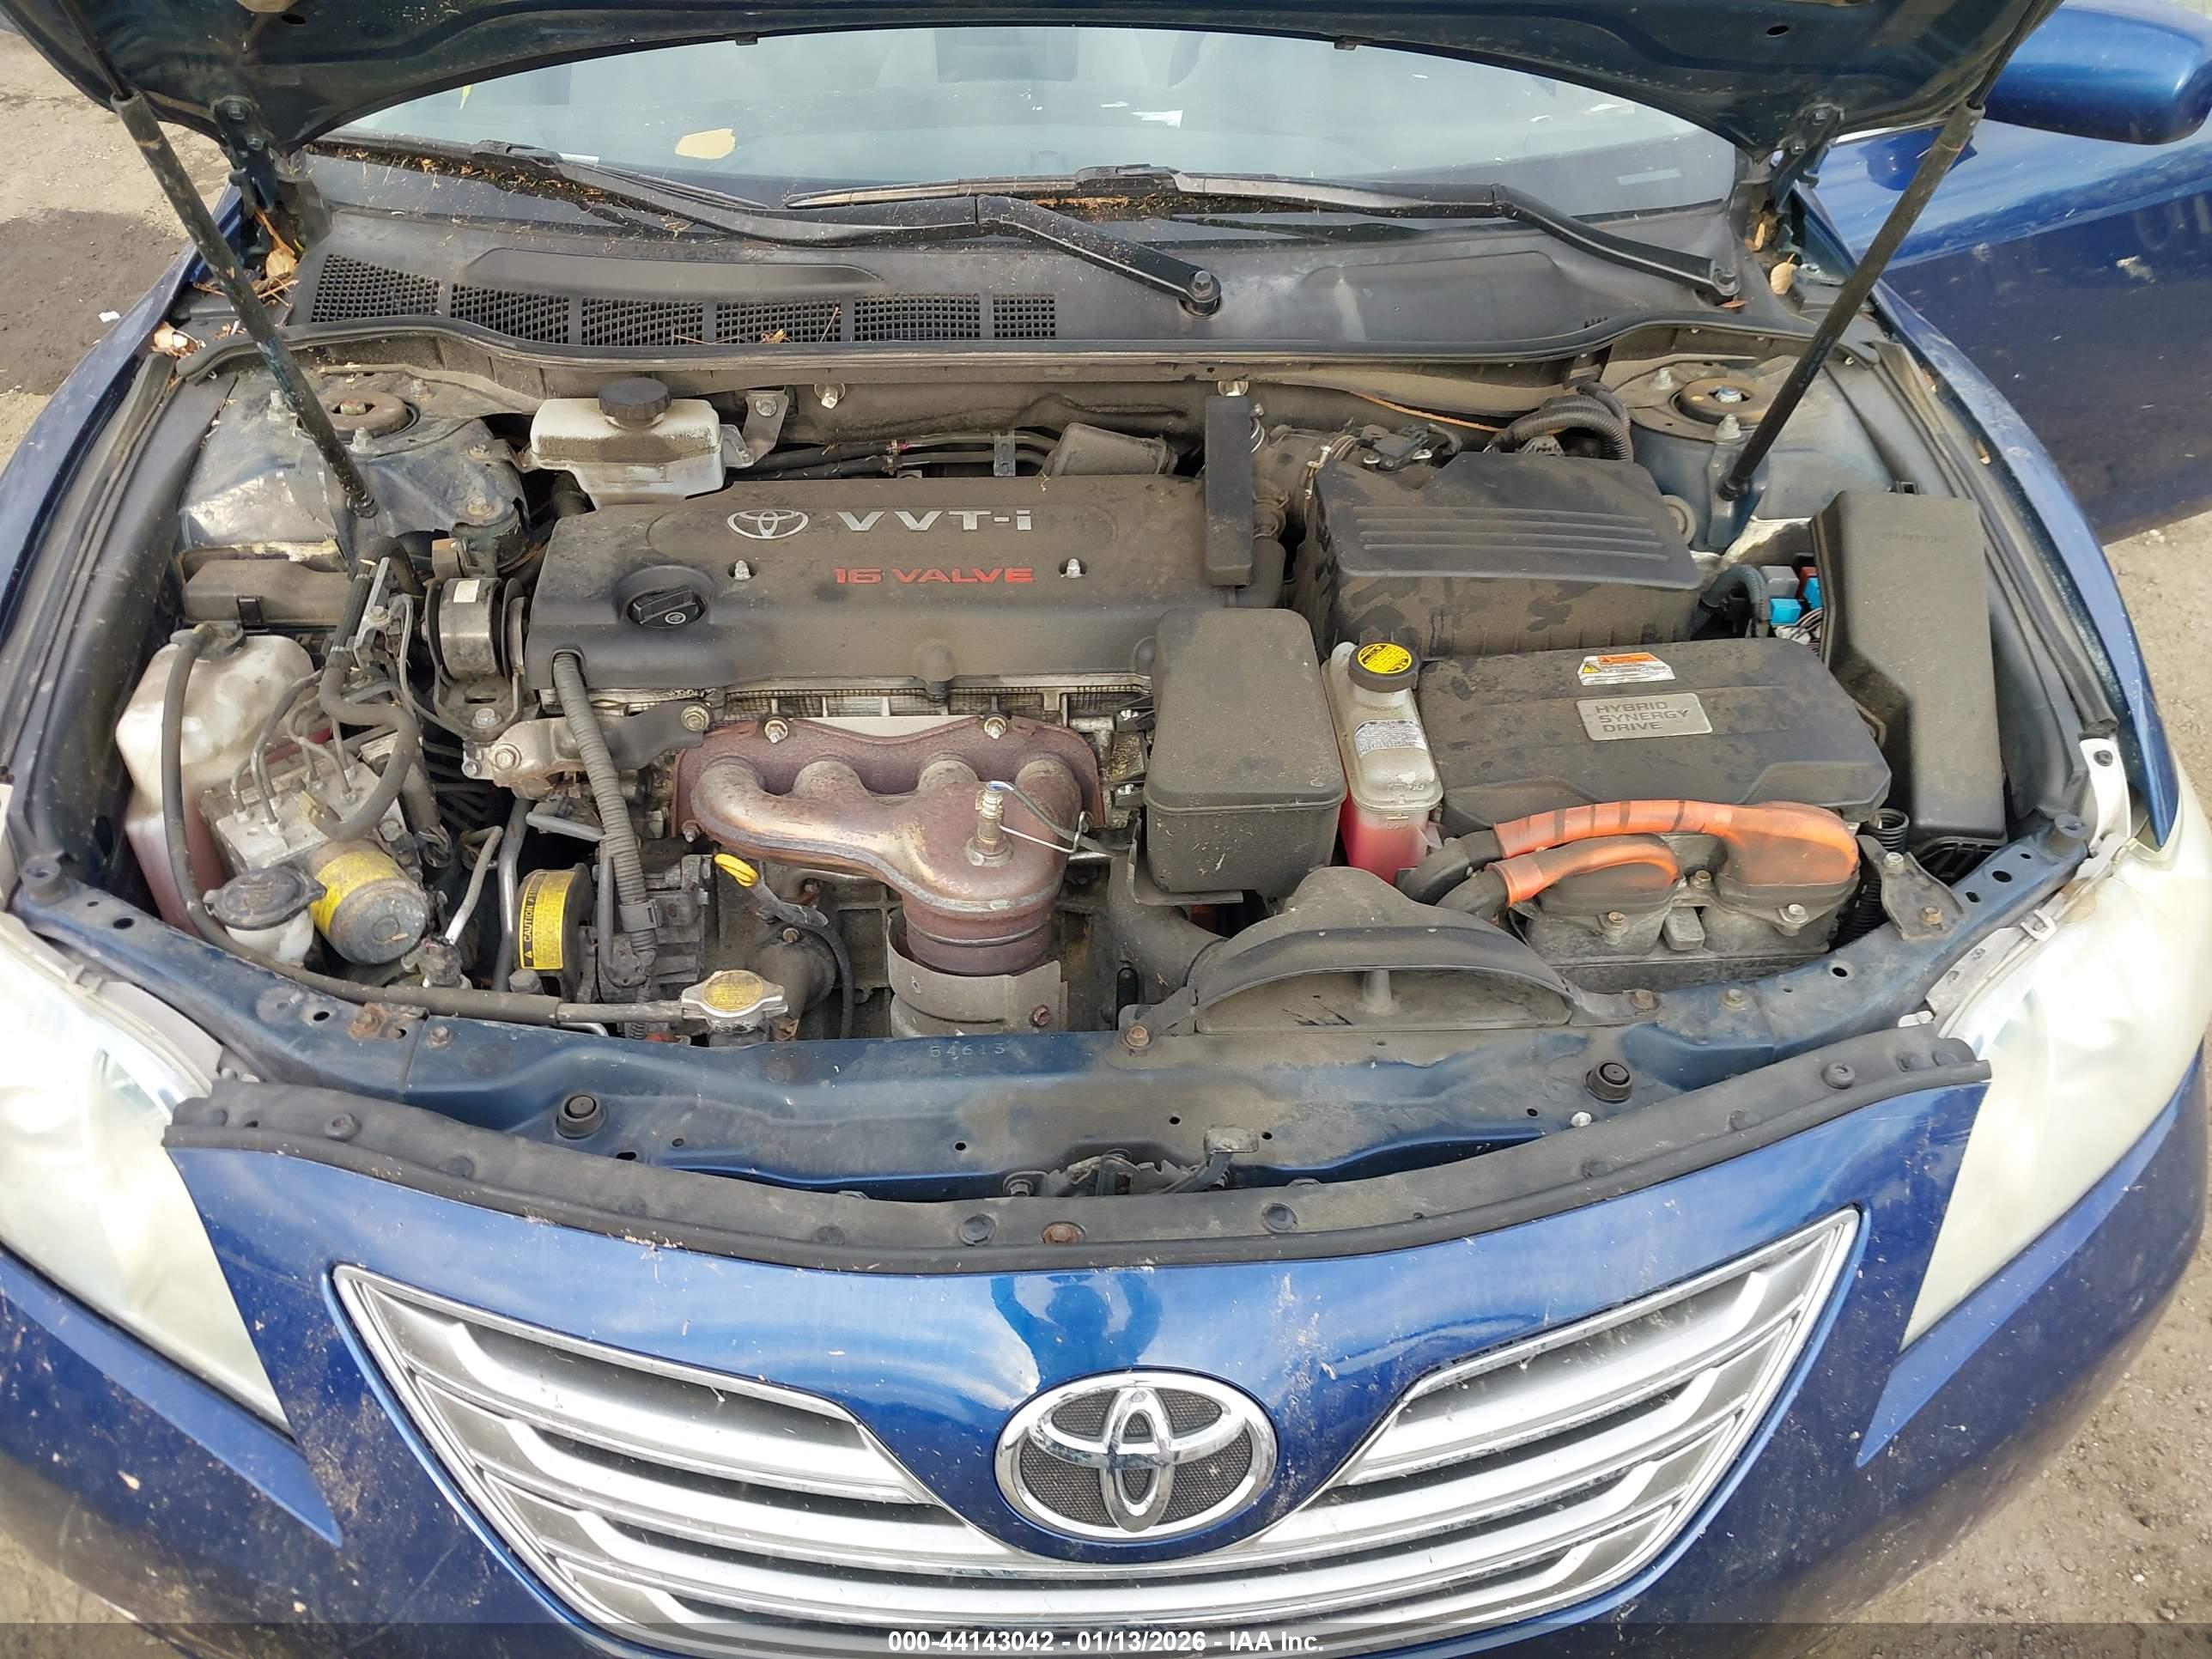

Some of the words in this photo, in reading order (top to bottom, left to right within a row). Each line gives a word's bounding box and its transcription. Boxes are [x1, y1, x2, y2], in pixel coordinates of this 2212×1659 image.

[836, 509, 1033, 532] VVT-i
[834, 568, 882, 584] 16
[891, 568, 1035, 584] VALVE
[1595, 701, 1668, 714] HYBRID
[1598, 709, 1689, 723] SYNERGY
[1602, 721, 1662, 732] DRIVE
[523, 904, 534, 942] CAUTION
[930, 1042, 1005, 1058] 54613
